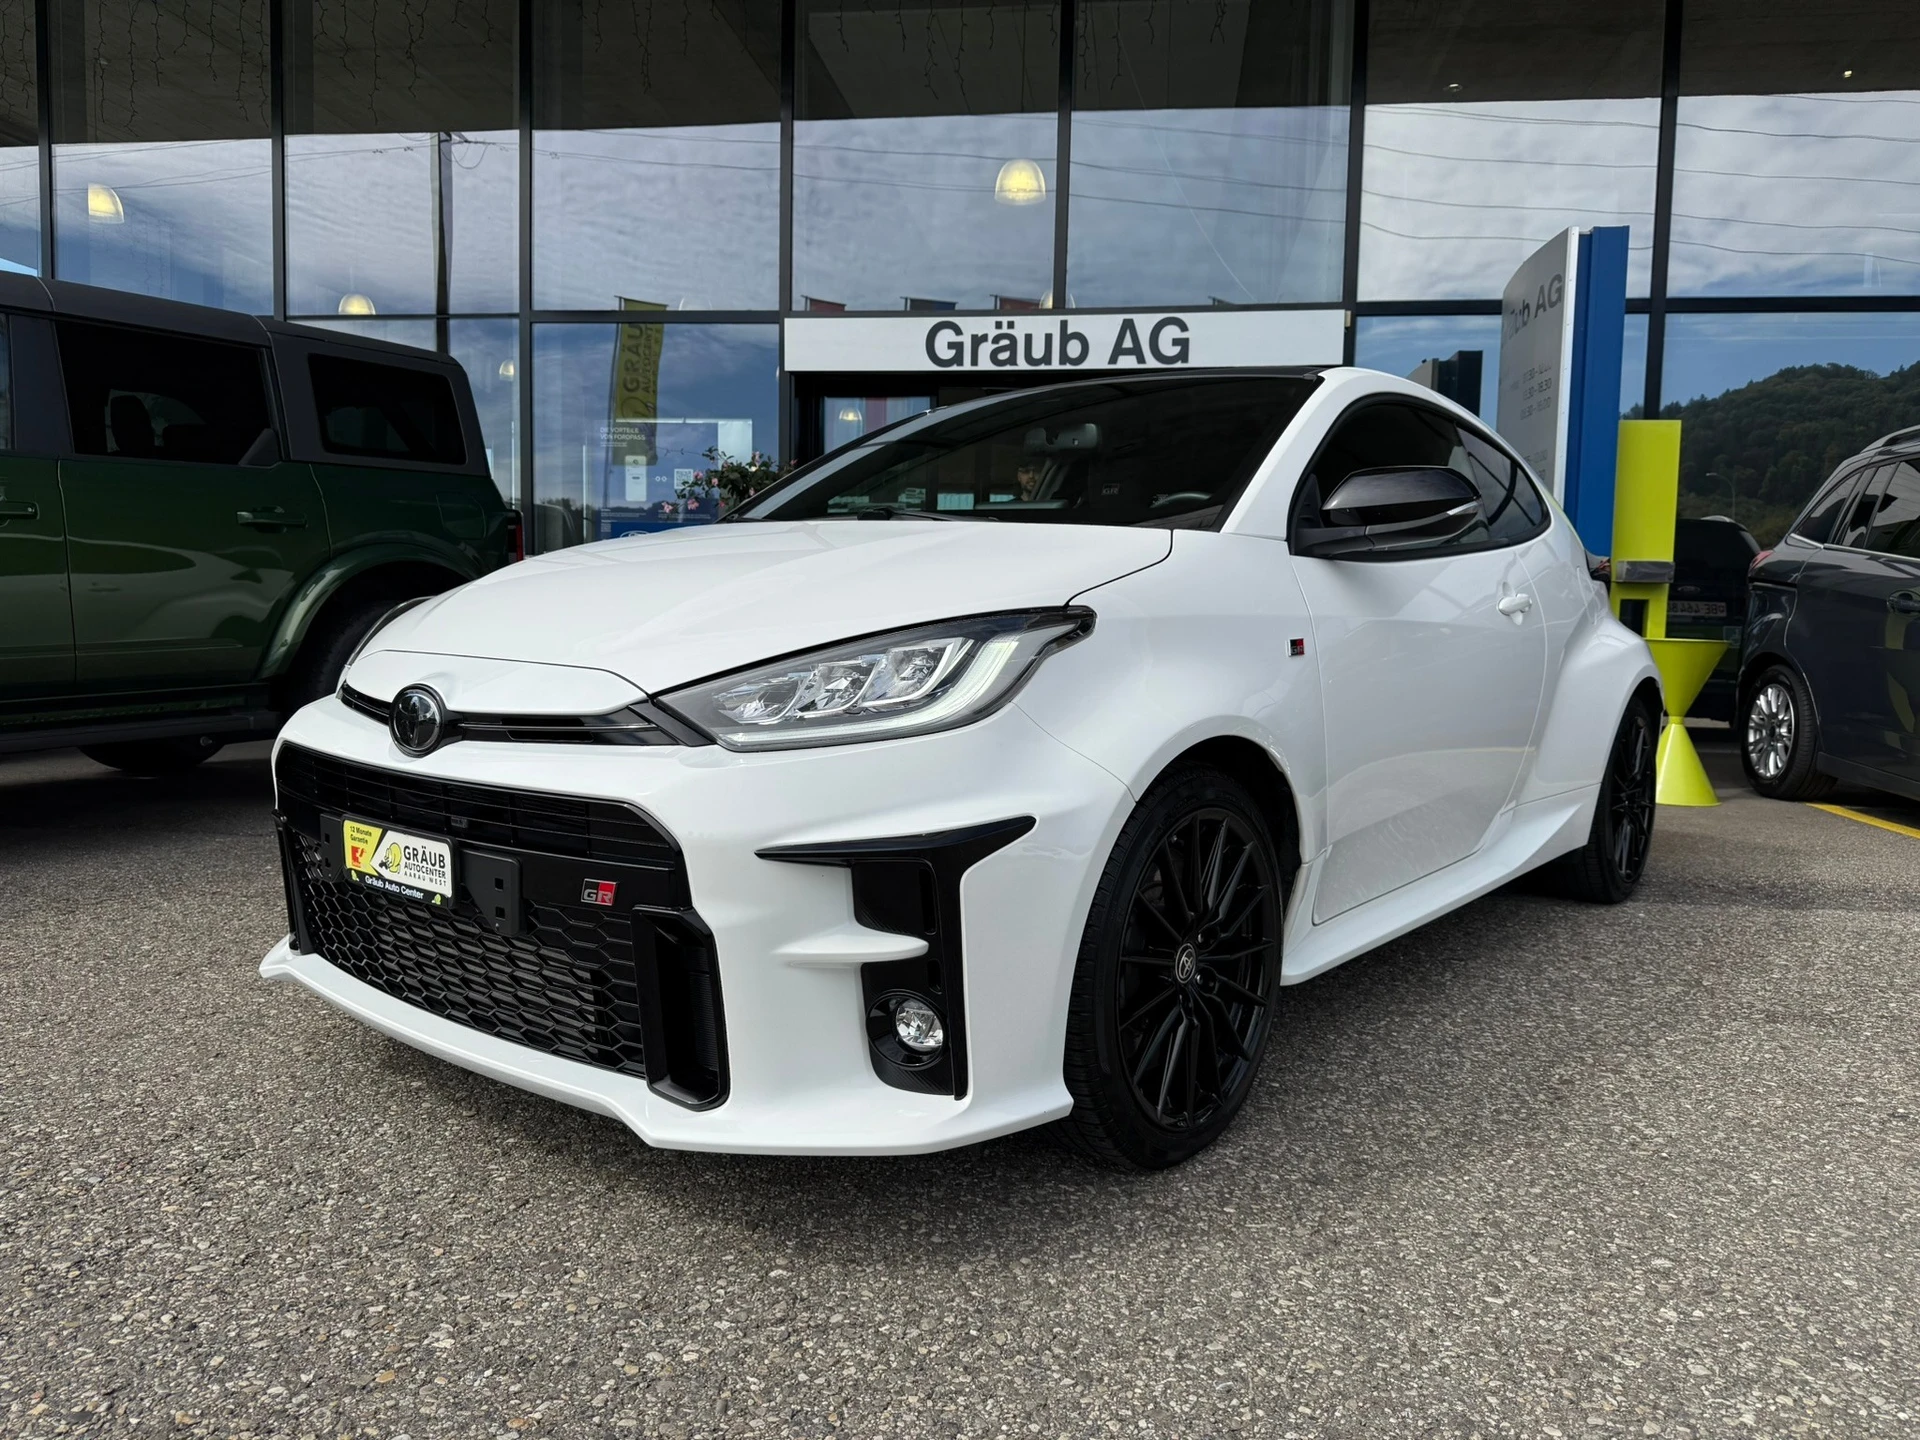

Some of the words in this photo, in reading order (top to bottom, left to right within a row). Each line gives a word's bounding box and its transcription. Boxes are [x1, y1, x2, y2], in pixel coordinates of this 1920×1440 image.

[1534, 274, 1563, 319] AG
[924, 319, 1090, 369] Gräub
[1107, 316, 1191, 367] AG
[621, 323, 643, 393] GRÄU
[641, 323, 654, 395] AUTOCENT
[350, 834, 368, 845] Garantie
[356, 827, 372, 837] Monate
[403, 845, 446, 869] GRÄUB
[404, 862, 446, 879] AUTOCENTER
[404, 871, 425, 881] AARAU
[429, 877, 446, 887] WEST
[365, 875, 384, 888] Gräub
[385, 881, 400, 893] Auto
[400, 885, 424, 899] Center
[583, 889, 612, 903] GR
